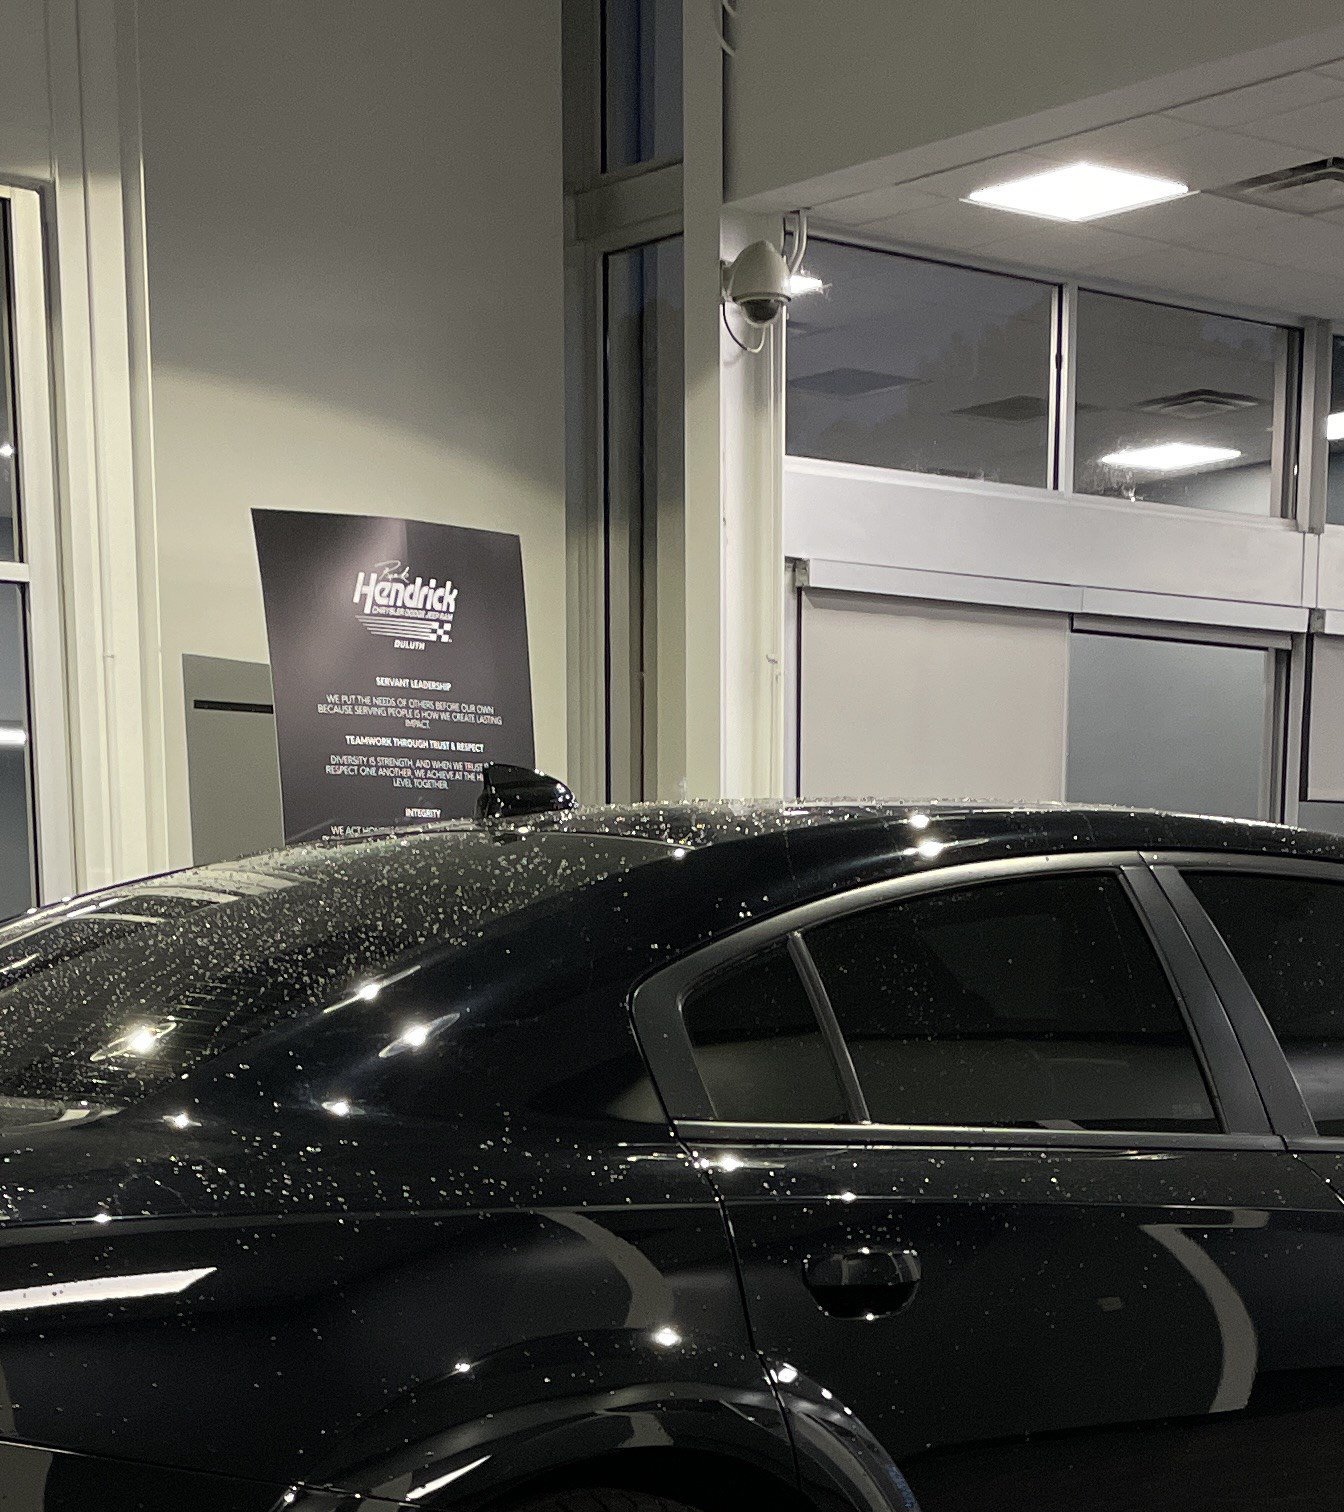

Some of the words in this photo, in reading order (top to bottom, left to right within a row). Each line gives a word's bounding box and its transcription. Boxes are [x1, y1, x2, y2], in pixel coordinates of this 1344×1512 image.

[353, 571, 458, 614] Hendrick
[393, 640, 425, 651] DULUTH
[375, 676, 410, 688] SERVANT
[410, 679, 452, 692] LEADERSHIP
[326, 693, 340, 704] WE
[341, 694, 356, 705] PUT
[357, 695, 372, 706] THE
[372, 696, 396, 707] NEEDS
[396, 697, 407, 708] OF
[408, 698, 435, 710] OTHERS
[435, 700, 460, 713] BEFORE
[460, 703, 476, 713] OUR
[476, 704, 494, 714] OWN
[317, 703, 353, 715] BECAUSE
[354, 705, 387, 717] SERVING
[387, 707, 413, 719] PEOPLE
[413, 709, 420, 719] IS
[421, 710, 439, 720] HOW
[439, 712, 451, 721] WE
[451, 712, 475, 723] CREATE
[476, 714, 503, 726] LASTING
[344, 735, 393, 747] TEAMWORK
[393, 737, 429, 749] THROUGH
[429, 739, 449, 750] TRUST
[450, 741, 456, 751] &
[456, 742, 484, 753] RESPECT
[330, 754, 368, 766] DIVERSITY
[368, 756, 376, 766] IS
[376, 757, 415, 769] STRENGTH,
[416, 759, 431, 769] AND
[431, 760, 452, 770] WHEN
[452, 761, 463, 771] WE
[464, 761, 483, 772] TRUST
[325, 764, 358, 775] RESPECT
[359, 766, 376, 776] ONE
[377, 767, 414, 778] ANOTHER,
[414, 769, 425, 778] WE
[426, 770, 455, 780] ACHIEVE
[455, 771, 463, 780] AT
[463, 772, 476, 782] THE
[393, 778, 412, 788] LEVEL
[405, 807, 441, 818] INTEGRITY
[330, 825, 344, 836] WE
[345, 825, 361, 836] ACT
